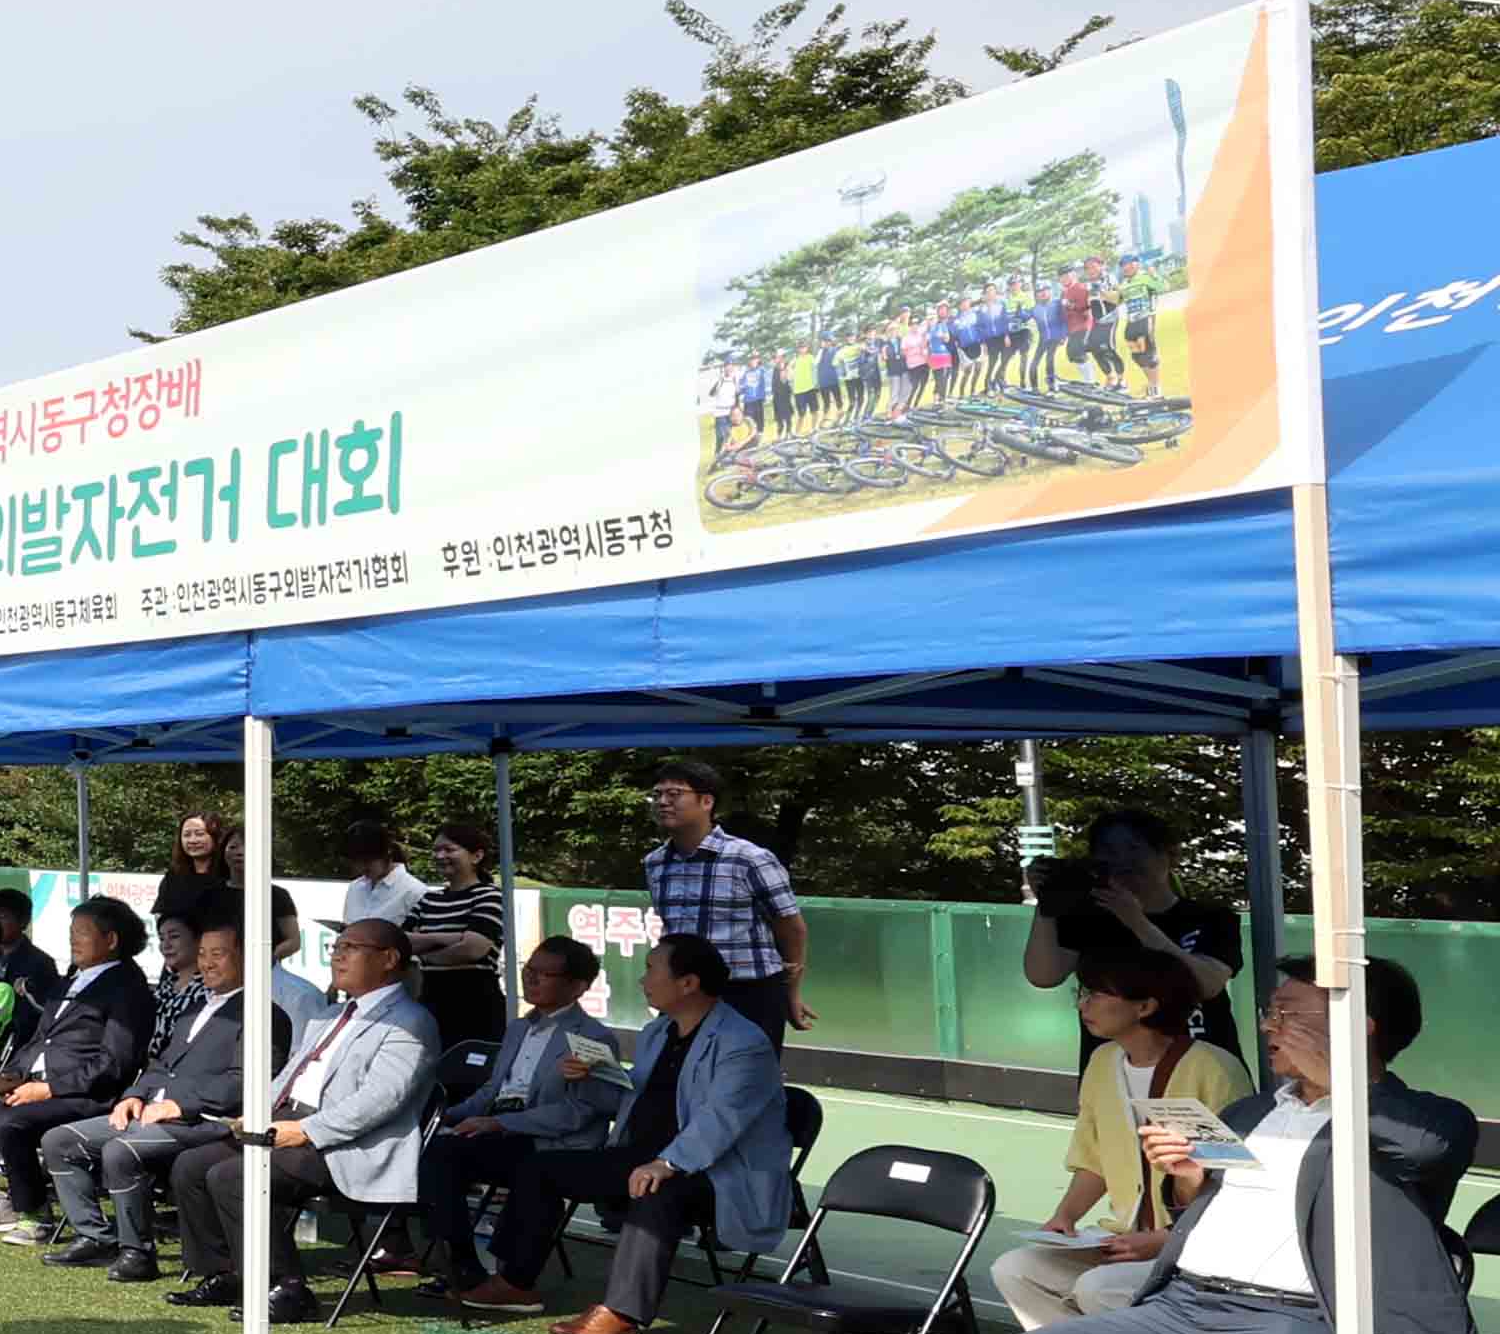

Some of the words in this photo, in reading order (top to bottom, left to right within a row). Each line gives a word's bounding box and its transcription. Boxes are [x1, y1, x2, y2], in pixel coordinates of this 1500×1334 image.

[266, 410, 402, 529] 대회
[441, 538, 482, 578] 후원
[141, 588, 170, 618] 주관
